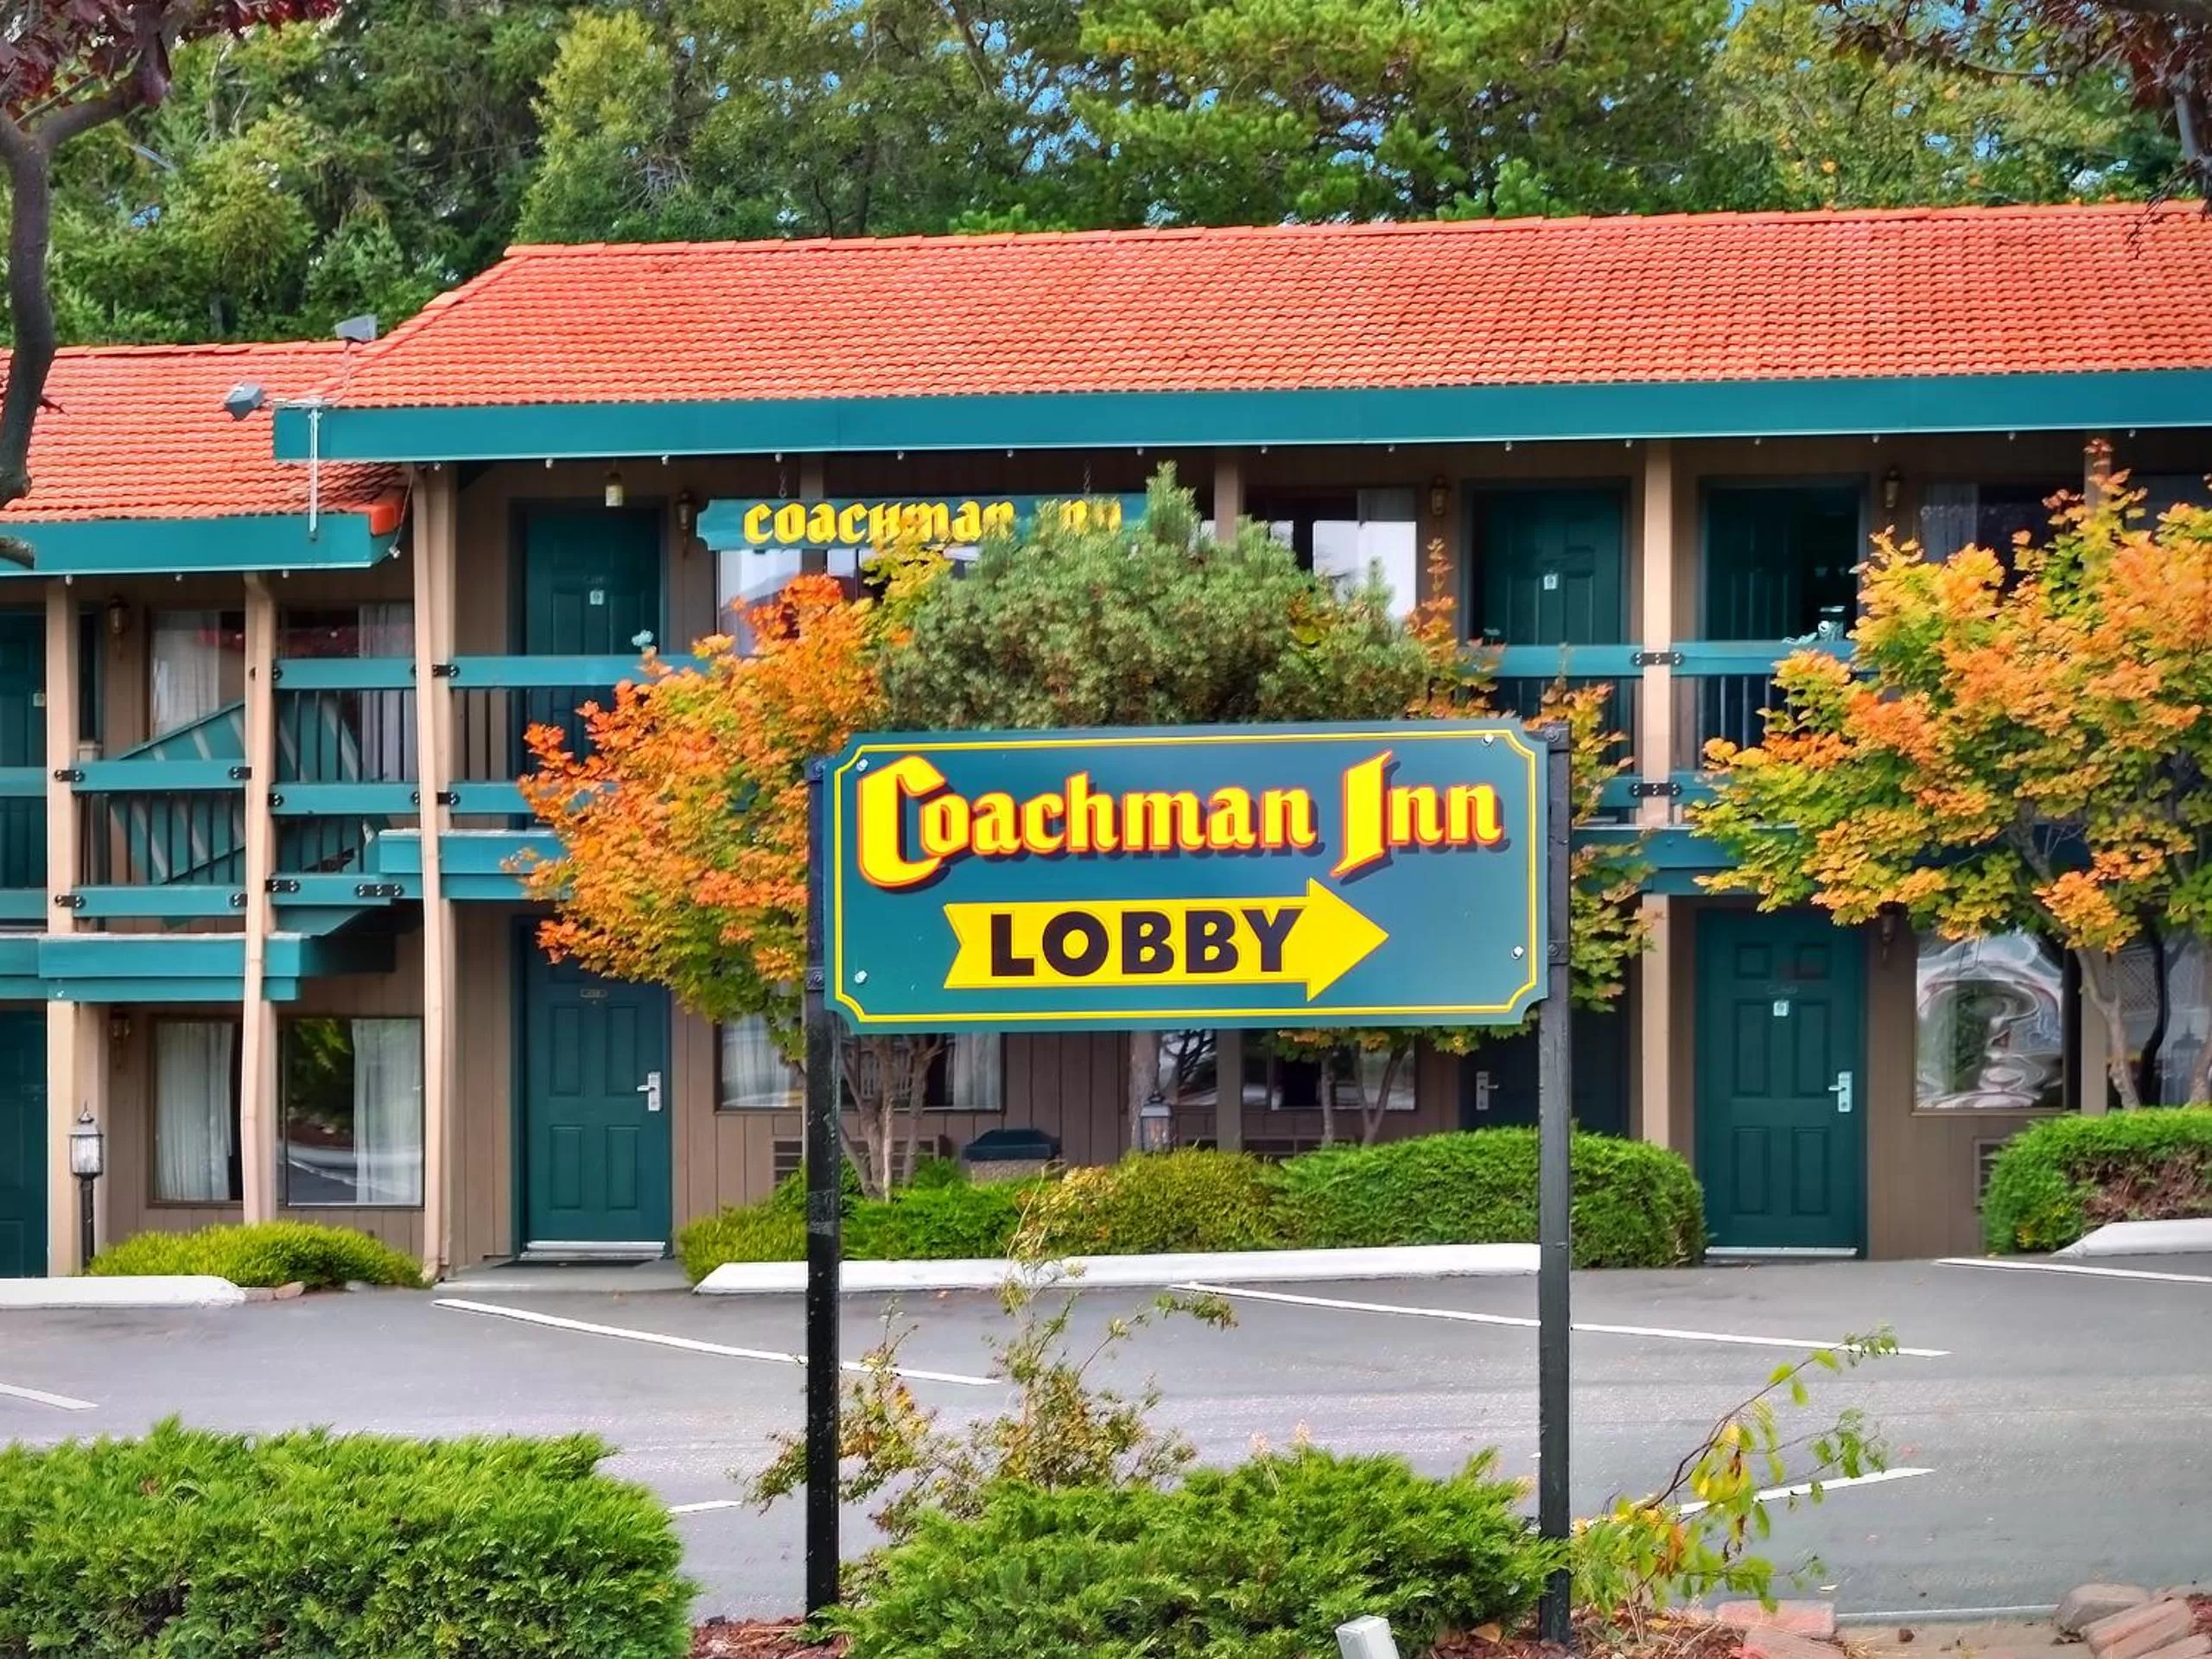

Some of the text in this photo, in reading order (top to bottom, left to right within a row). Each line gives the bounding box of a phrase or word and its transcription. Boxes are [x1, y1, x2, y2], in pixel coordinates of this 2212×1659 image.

[858, 749, 1505, 887] Coachman Inn
[990, 908, 1305, 978] LOBBY
